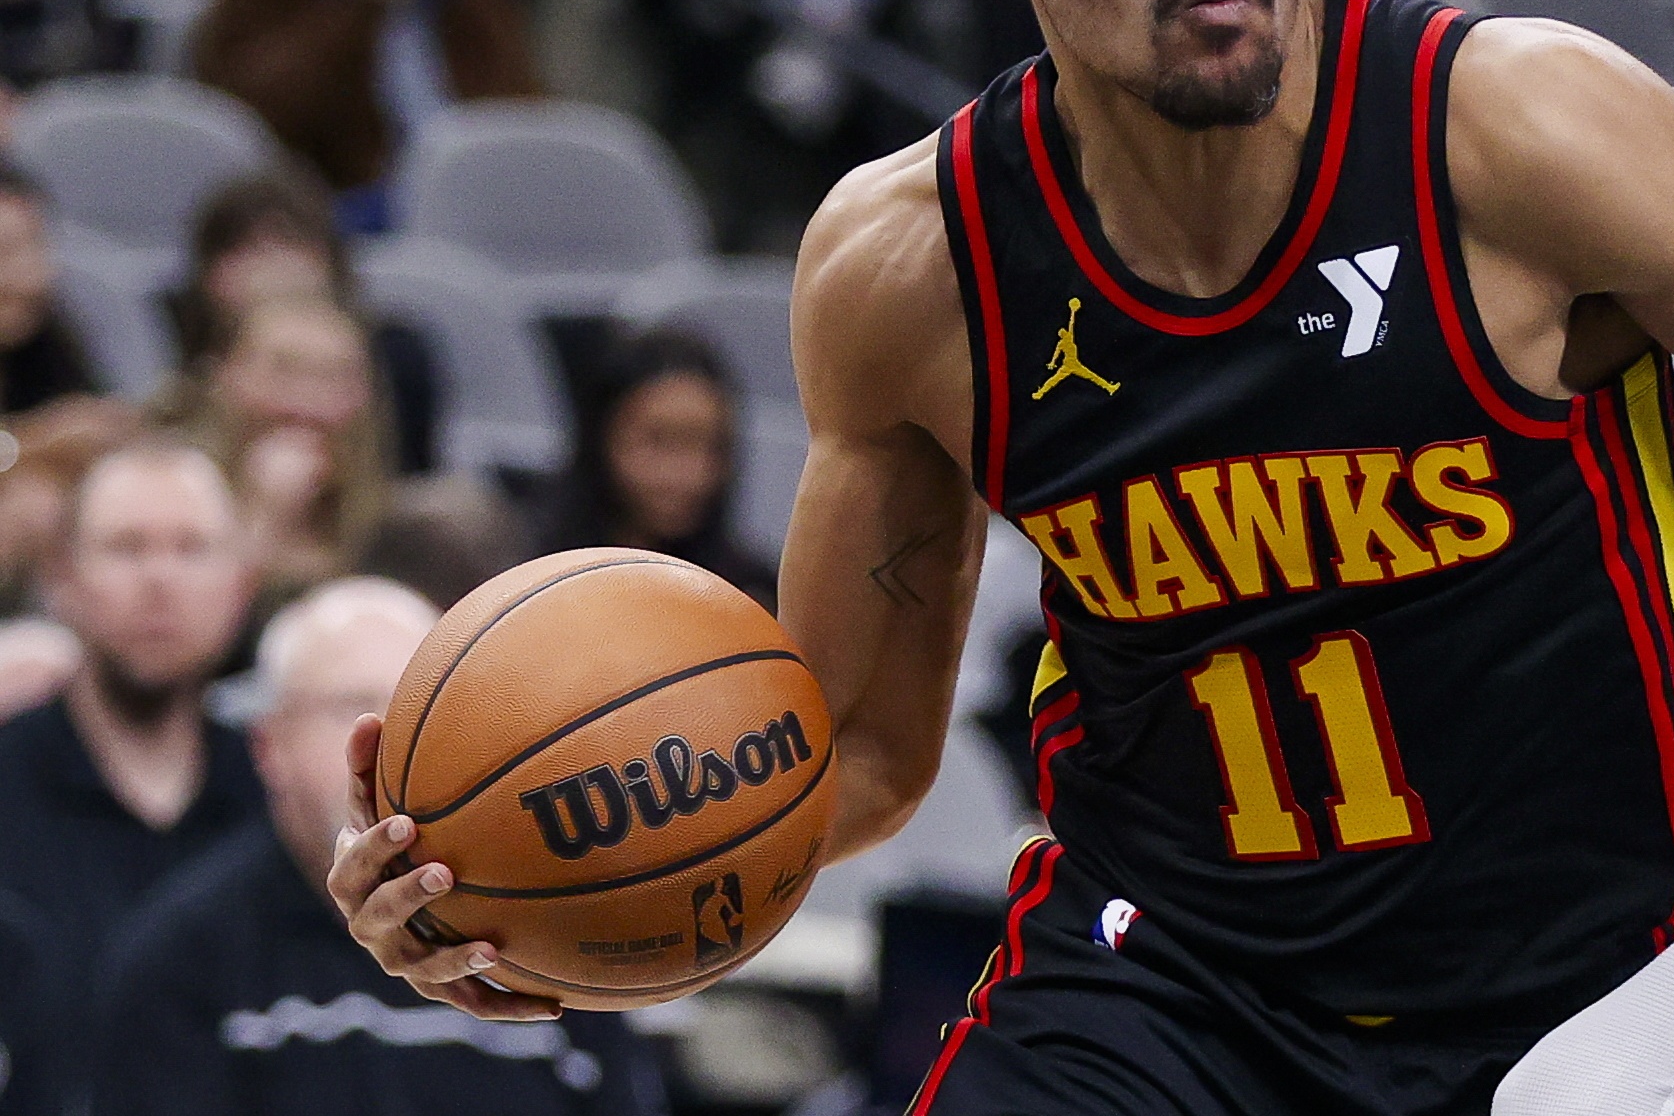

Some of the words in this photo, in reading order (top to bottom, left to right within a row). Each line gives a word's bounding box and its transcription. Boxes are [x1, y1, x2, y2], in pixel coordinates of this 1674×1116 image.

[1298, 313, 1336, 335] the
[1317, 245, 1400, 358] Y
[1020, 436, 1514, 621] HAWKS
[519, 710, 811, 860] Wilson
[1183, 629, 1431, 861] 11
